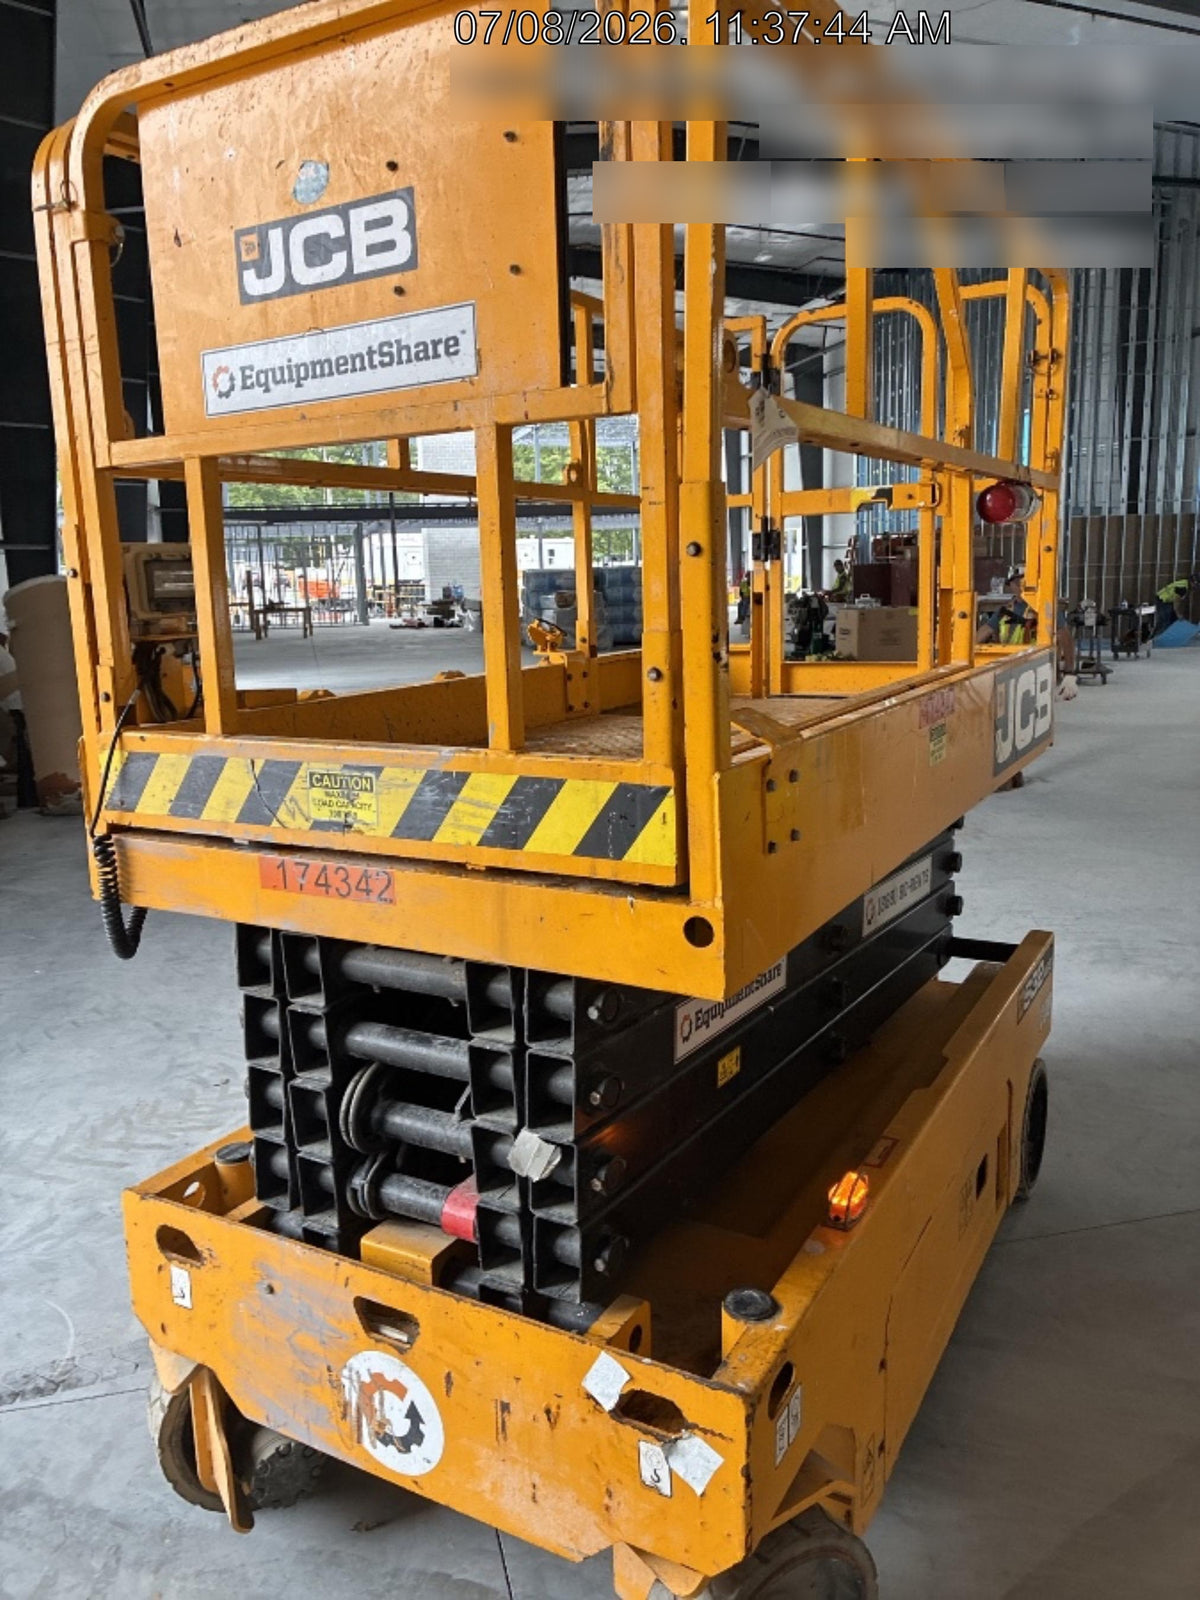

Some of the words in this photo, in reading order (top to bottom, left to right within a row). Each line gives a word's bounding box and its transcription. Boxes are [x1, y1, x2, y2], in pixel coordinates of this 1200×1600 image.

[242, 198, 412, 296] JCB
[240, 334, 460, 393] EquipmentShare
[995, 662, 1052, 764] JCB
[312, 774, 371, 791] CAUTION
[276, 859, 394, 903] 174342
